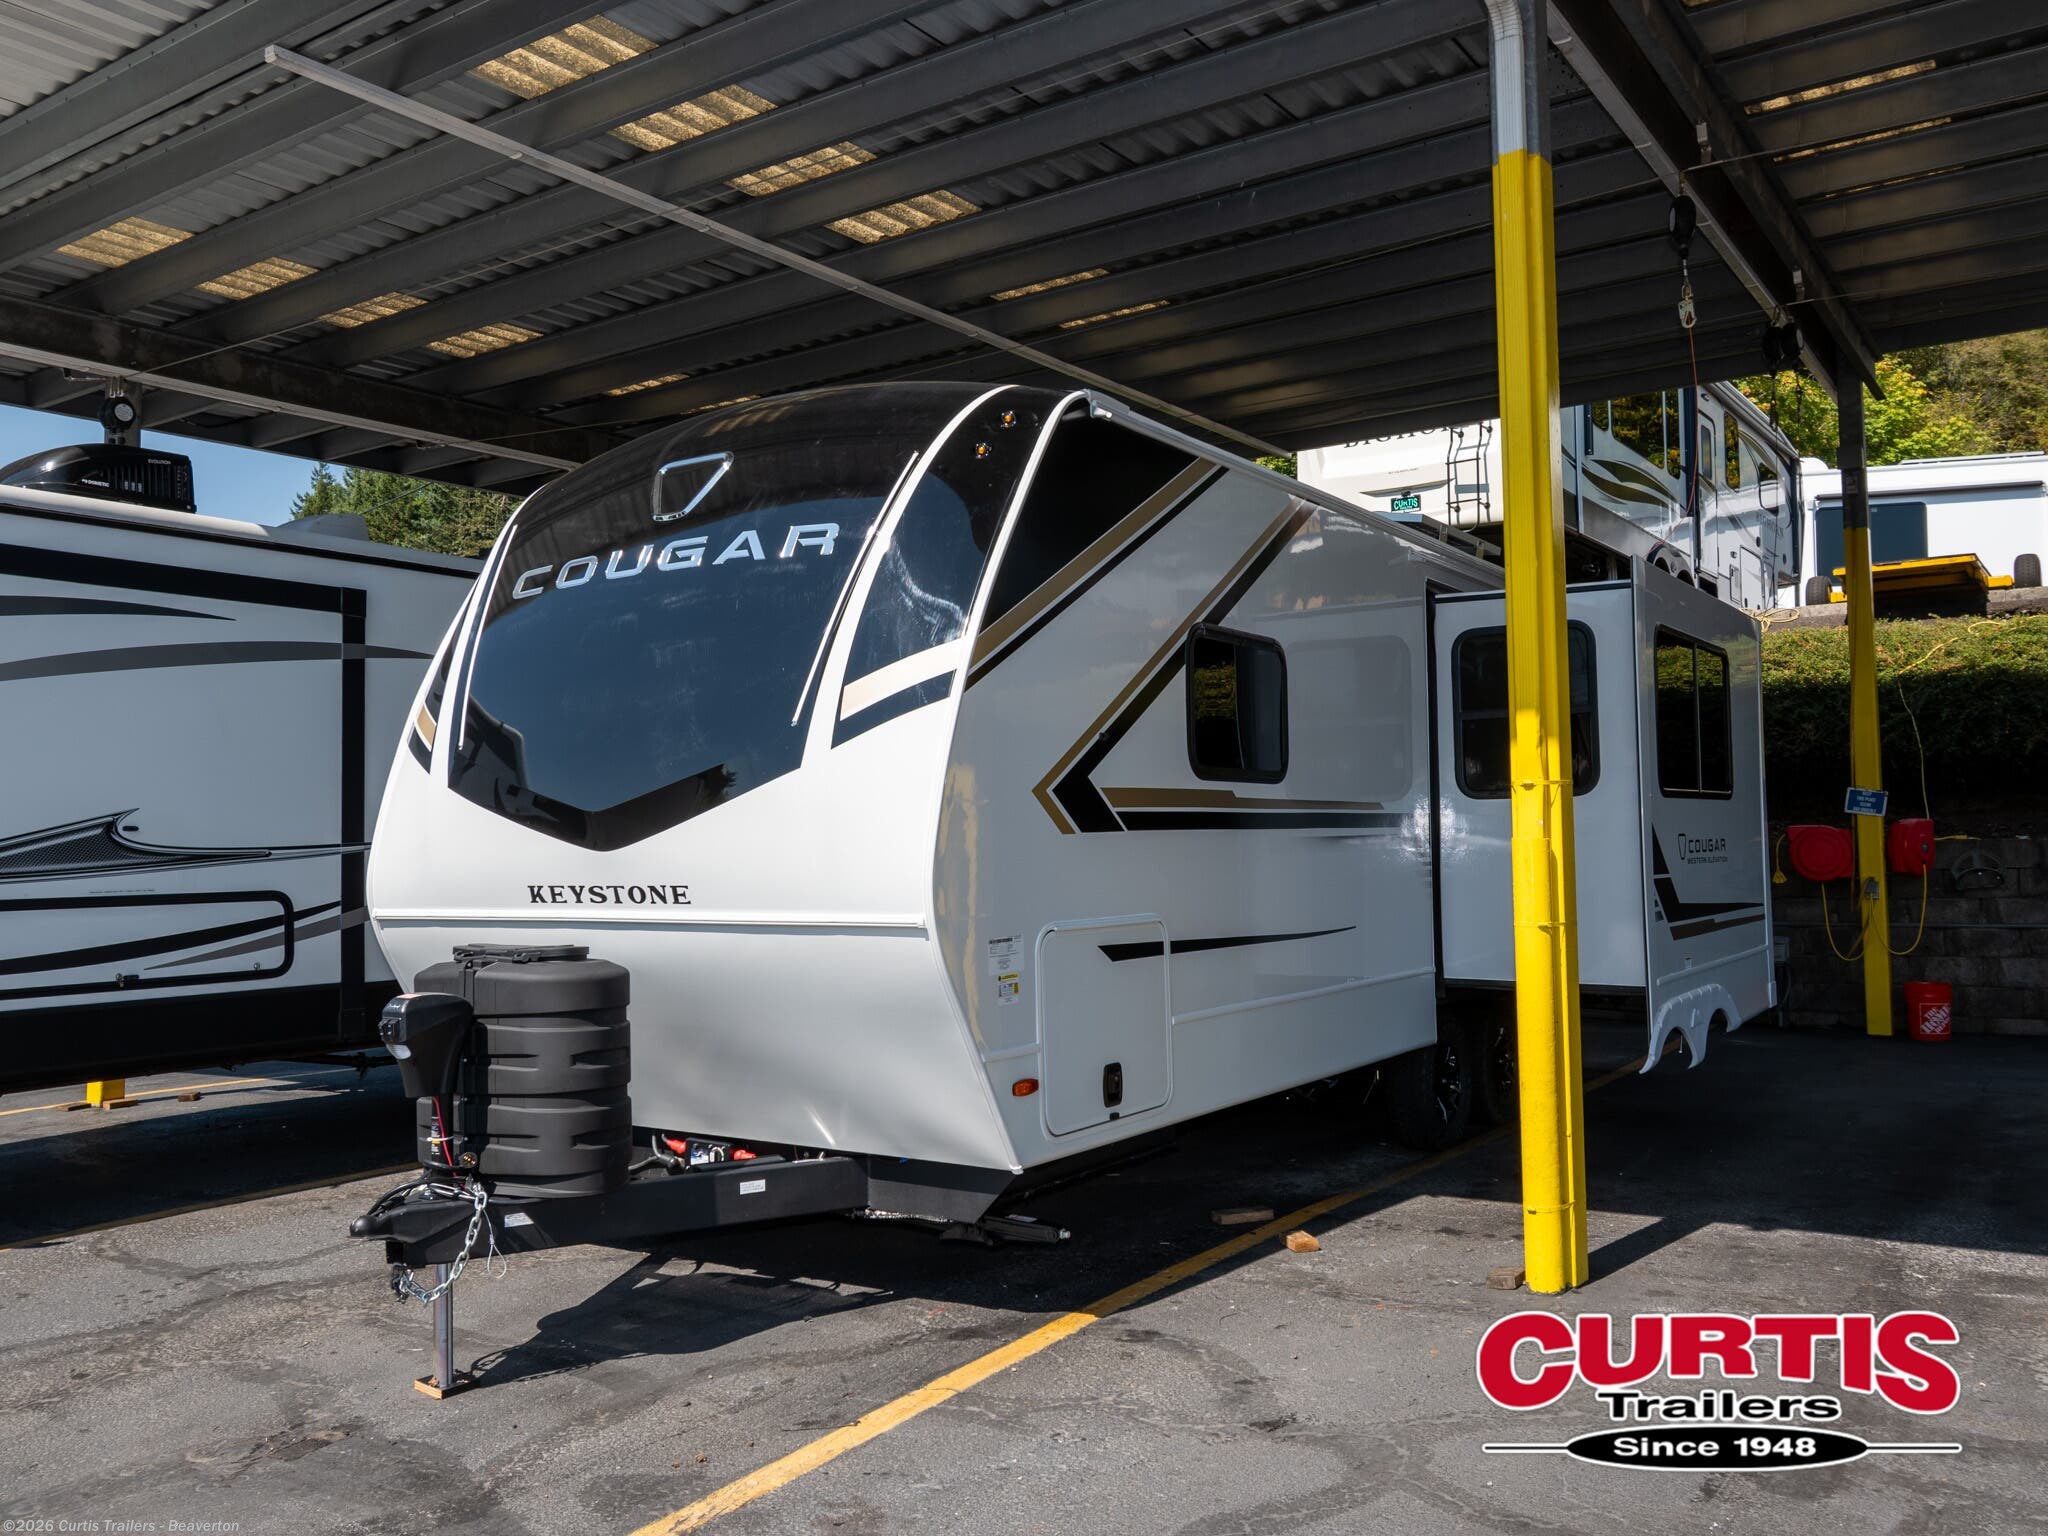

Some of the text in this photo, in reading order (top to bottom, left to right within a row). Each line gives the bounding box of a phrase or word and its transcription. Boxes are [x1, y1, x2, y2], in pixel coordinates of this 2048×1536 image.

[512, 522, 840, 600] COUGAR
[1688, 838, 1727, 853] COUGAR
[528, 885, 691, 904] KEYSTONE
